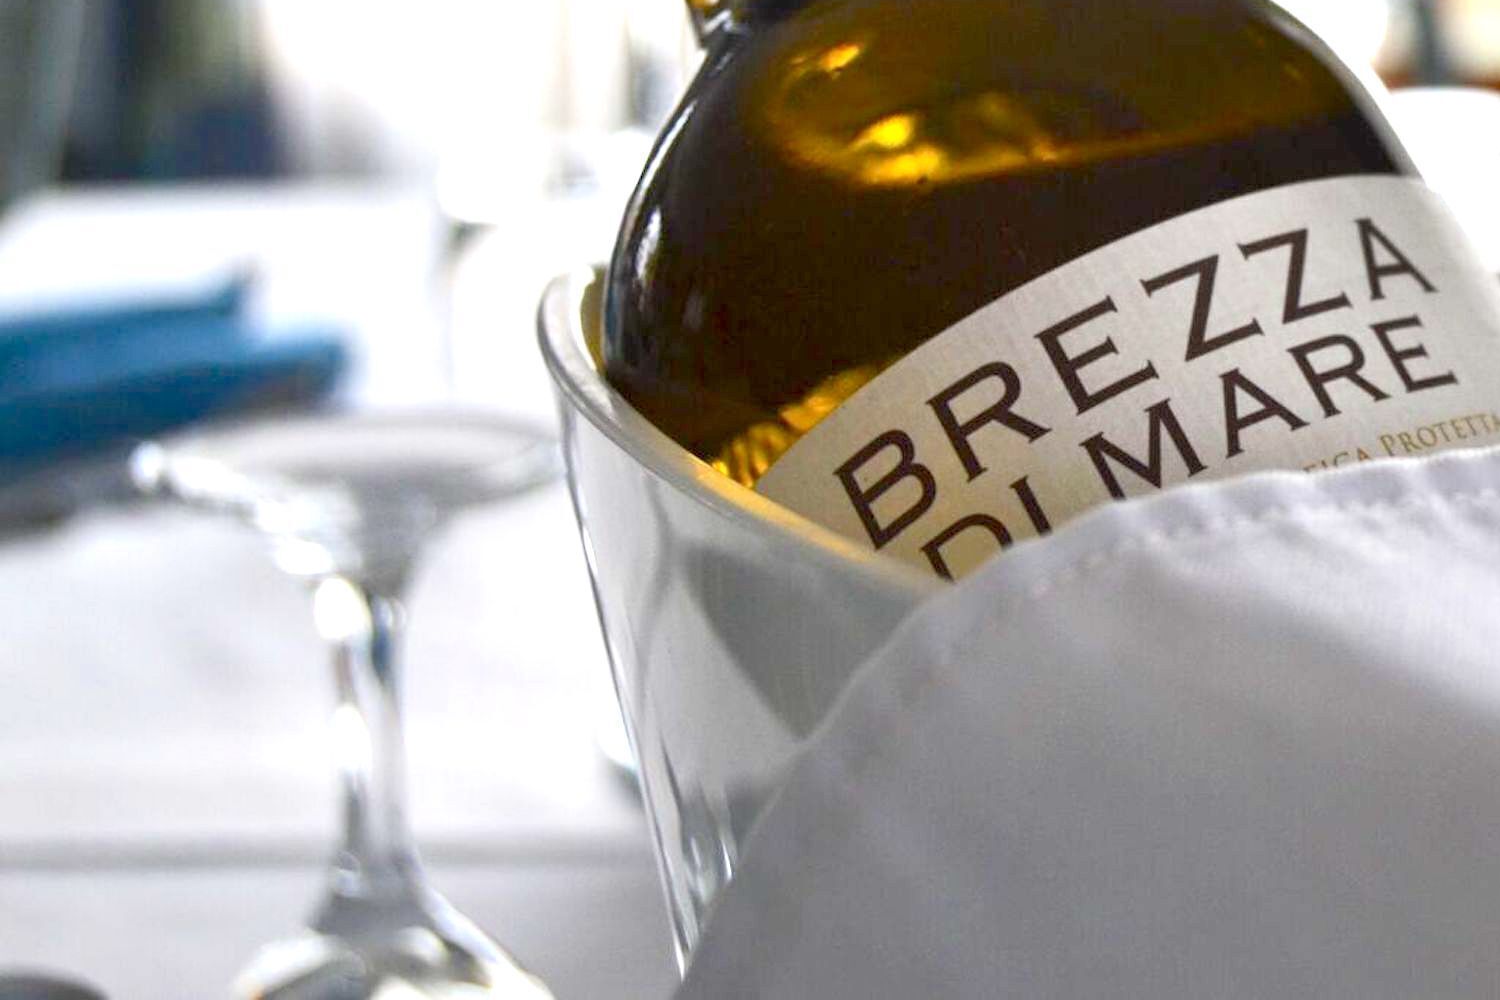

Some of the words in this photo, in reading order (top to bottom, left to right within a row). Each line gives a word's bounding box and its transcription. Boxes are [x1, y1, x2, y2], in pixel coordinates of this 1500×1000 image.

[833, 217, 1438, 549] BREZZA
[920, 475, 1051, 582] DI
[1079, 314, 1458, 500] MARE
